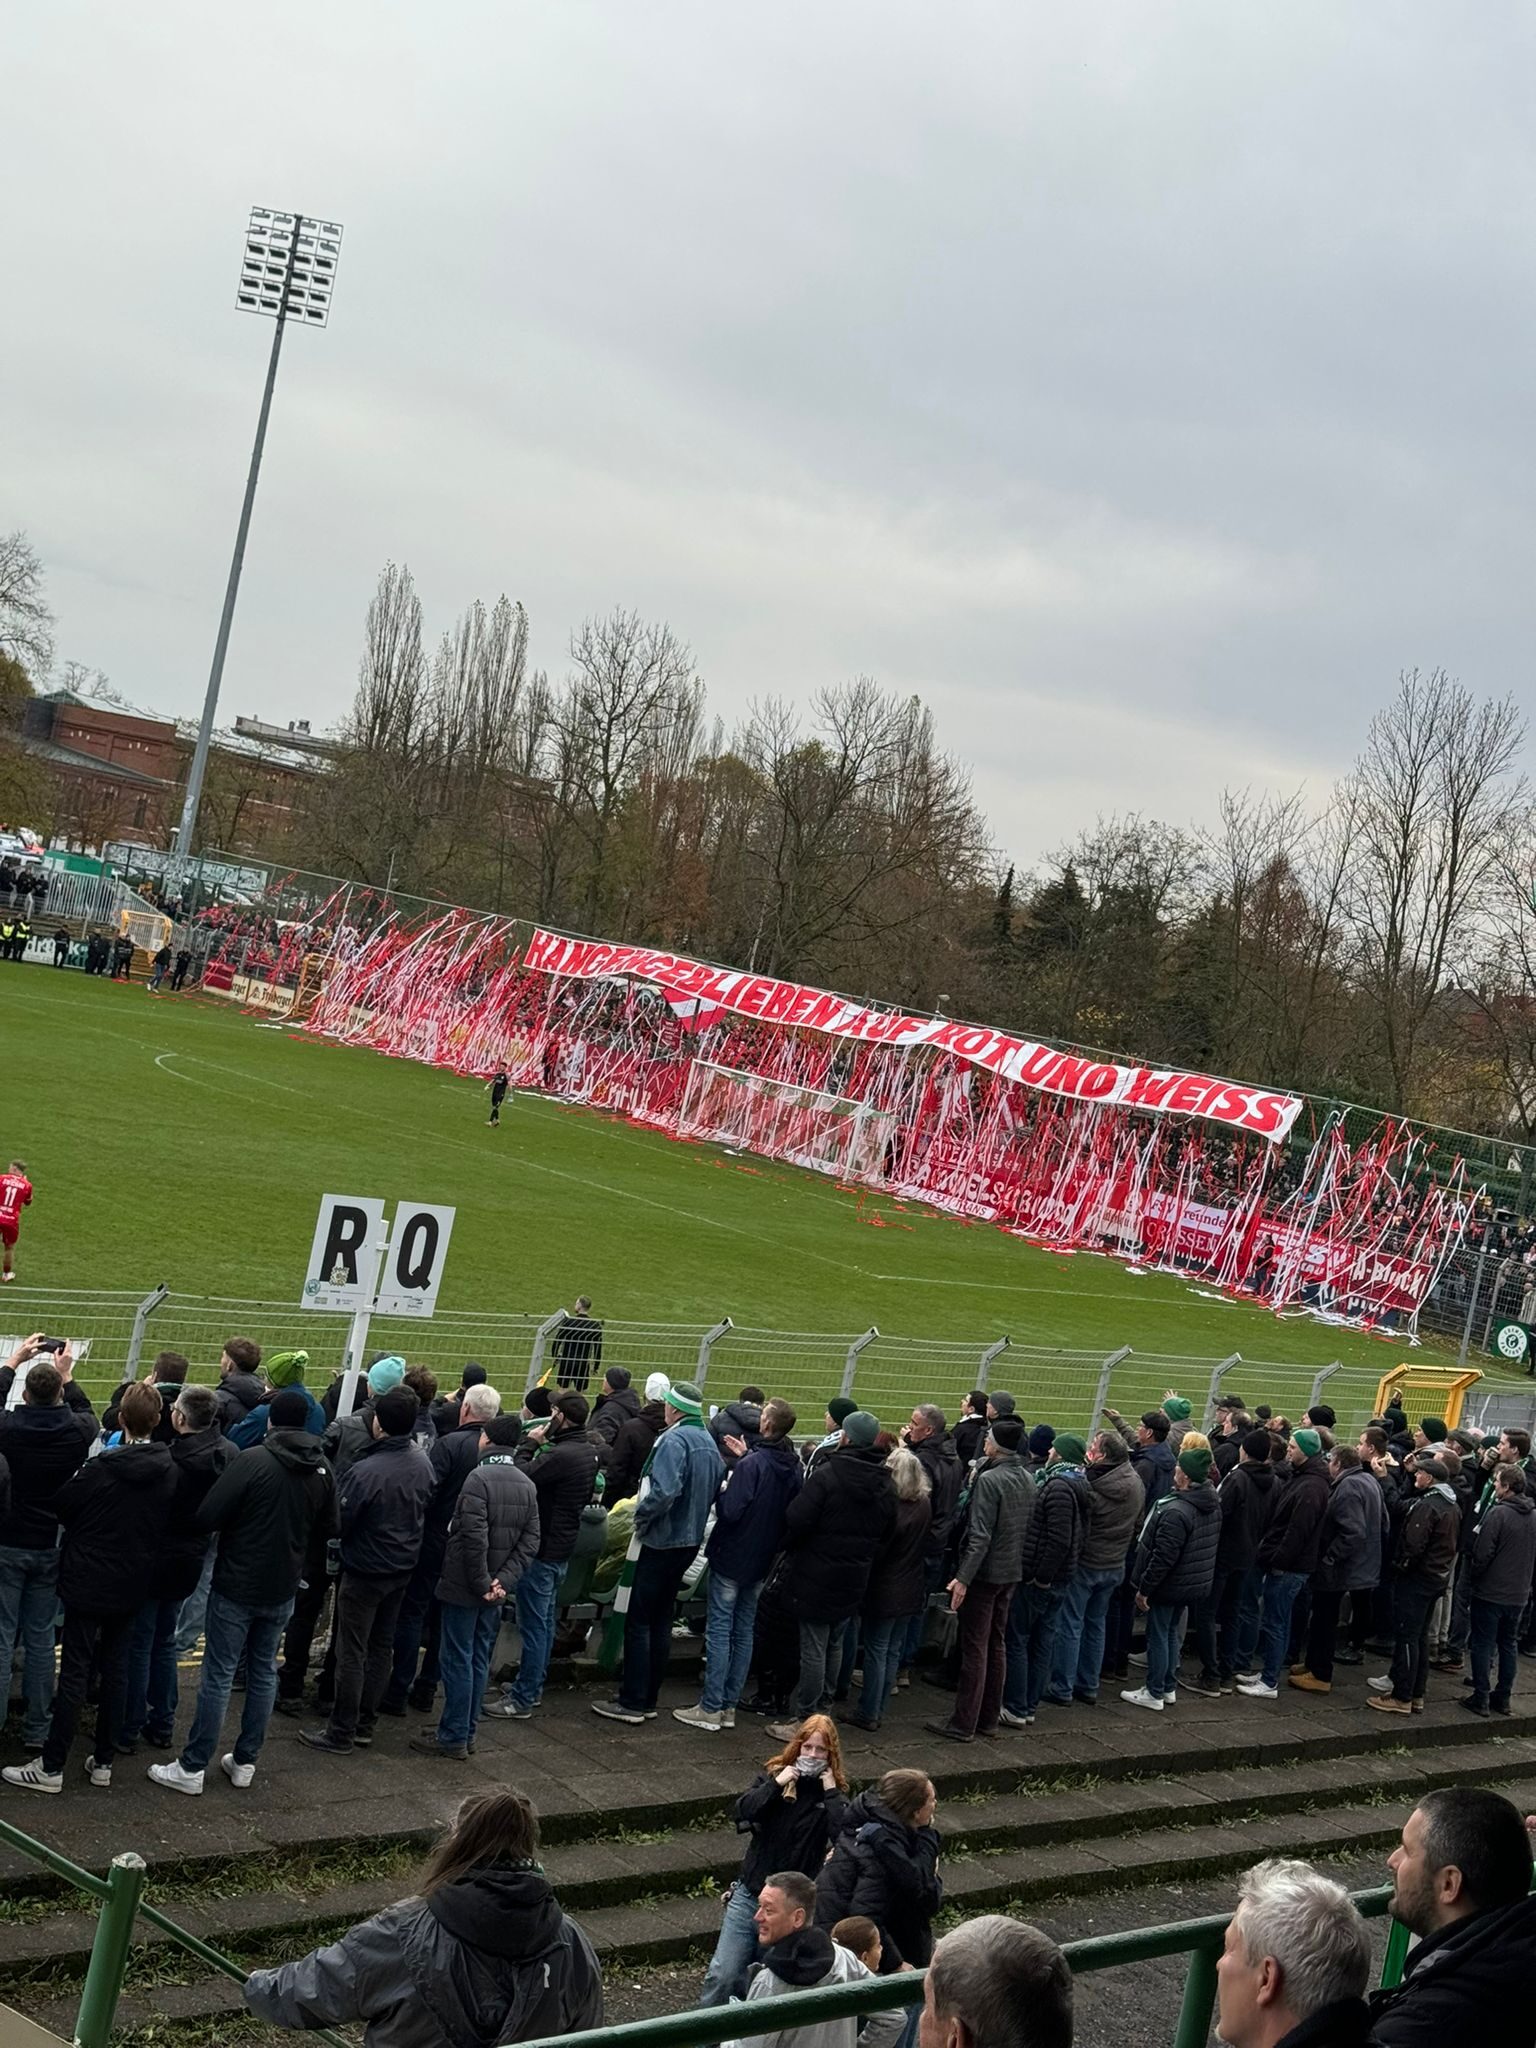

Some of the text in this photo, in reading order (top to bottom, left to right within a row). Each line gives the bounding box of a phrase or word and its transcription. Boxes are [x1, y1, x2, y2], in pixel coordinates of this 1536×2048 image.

[832, 1010, 930, 1041] AUF
[928, 1023, 1017, 1068] ROT
[1020, 1045, 1118, 1098] UND
[1122, 1069, 1293, 1132] WEISS
[3, 1186, 17, 1207] 11
[319, 1205, 368, 1284] R
[396, 1212, 439, 1291] Q
